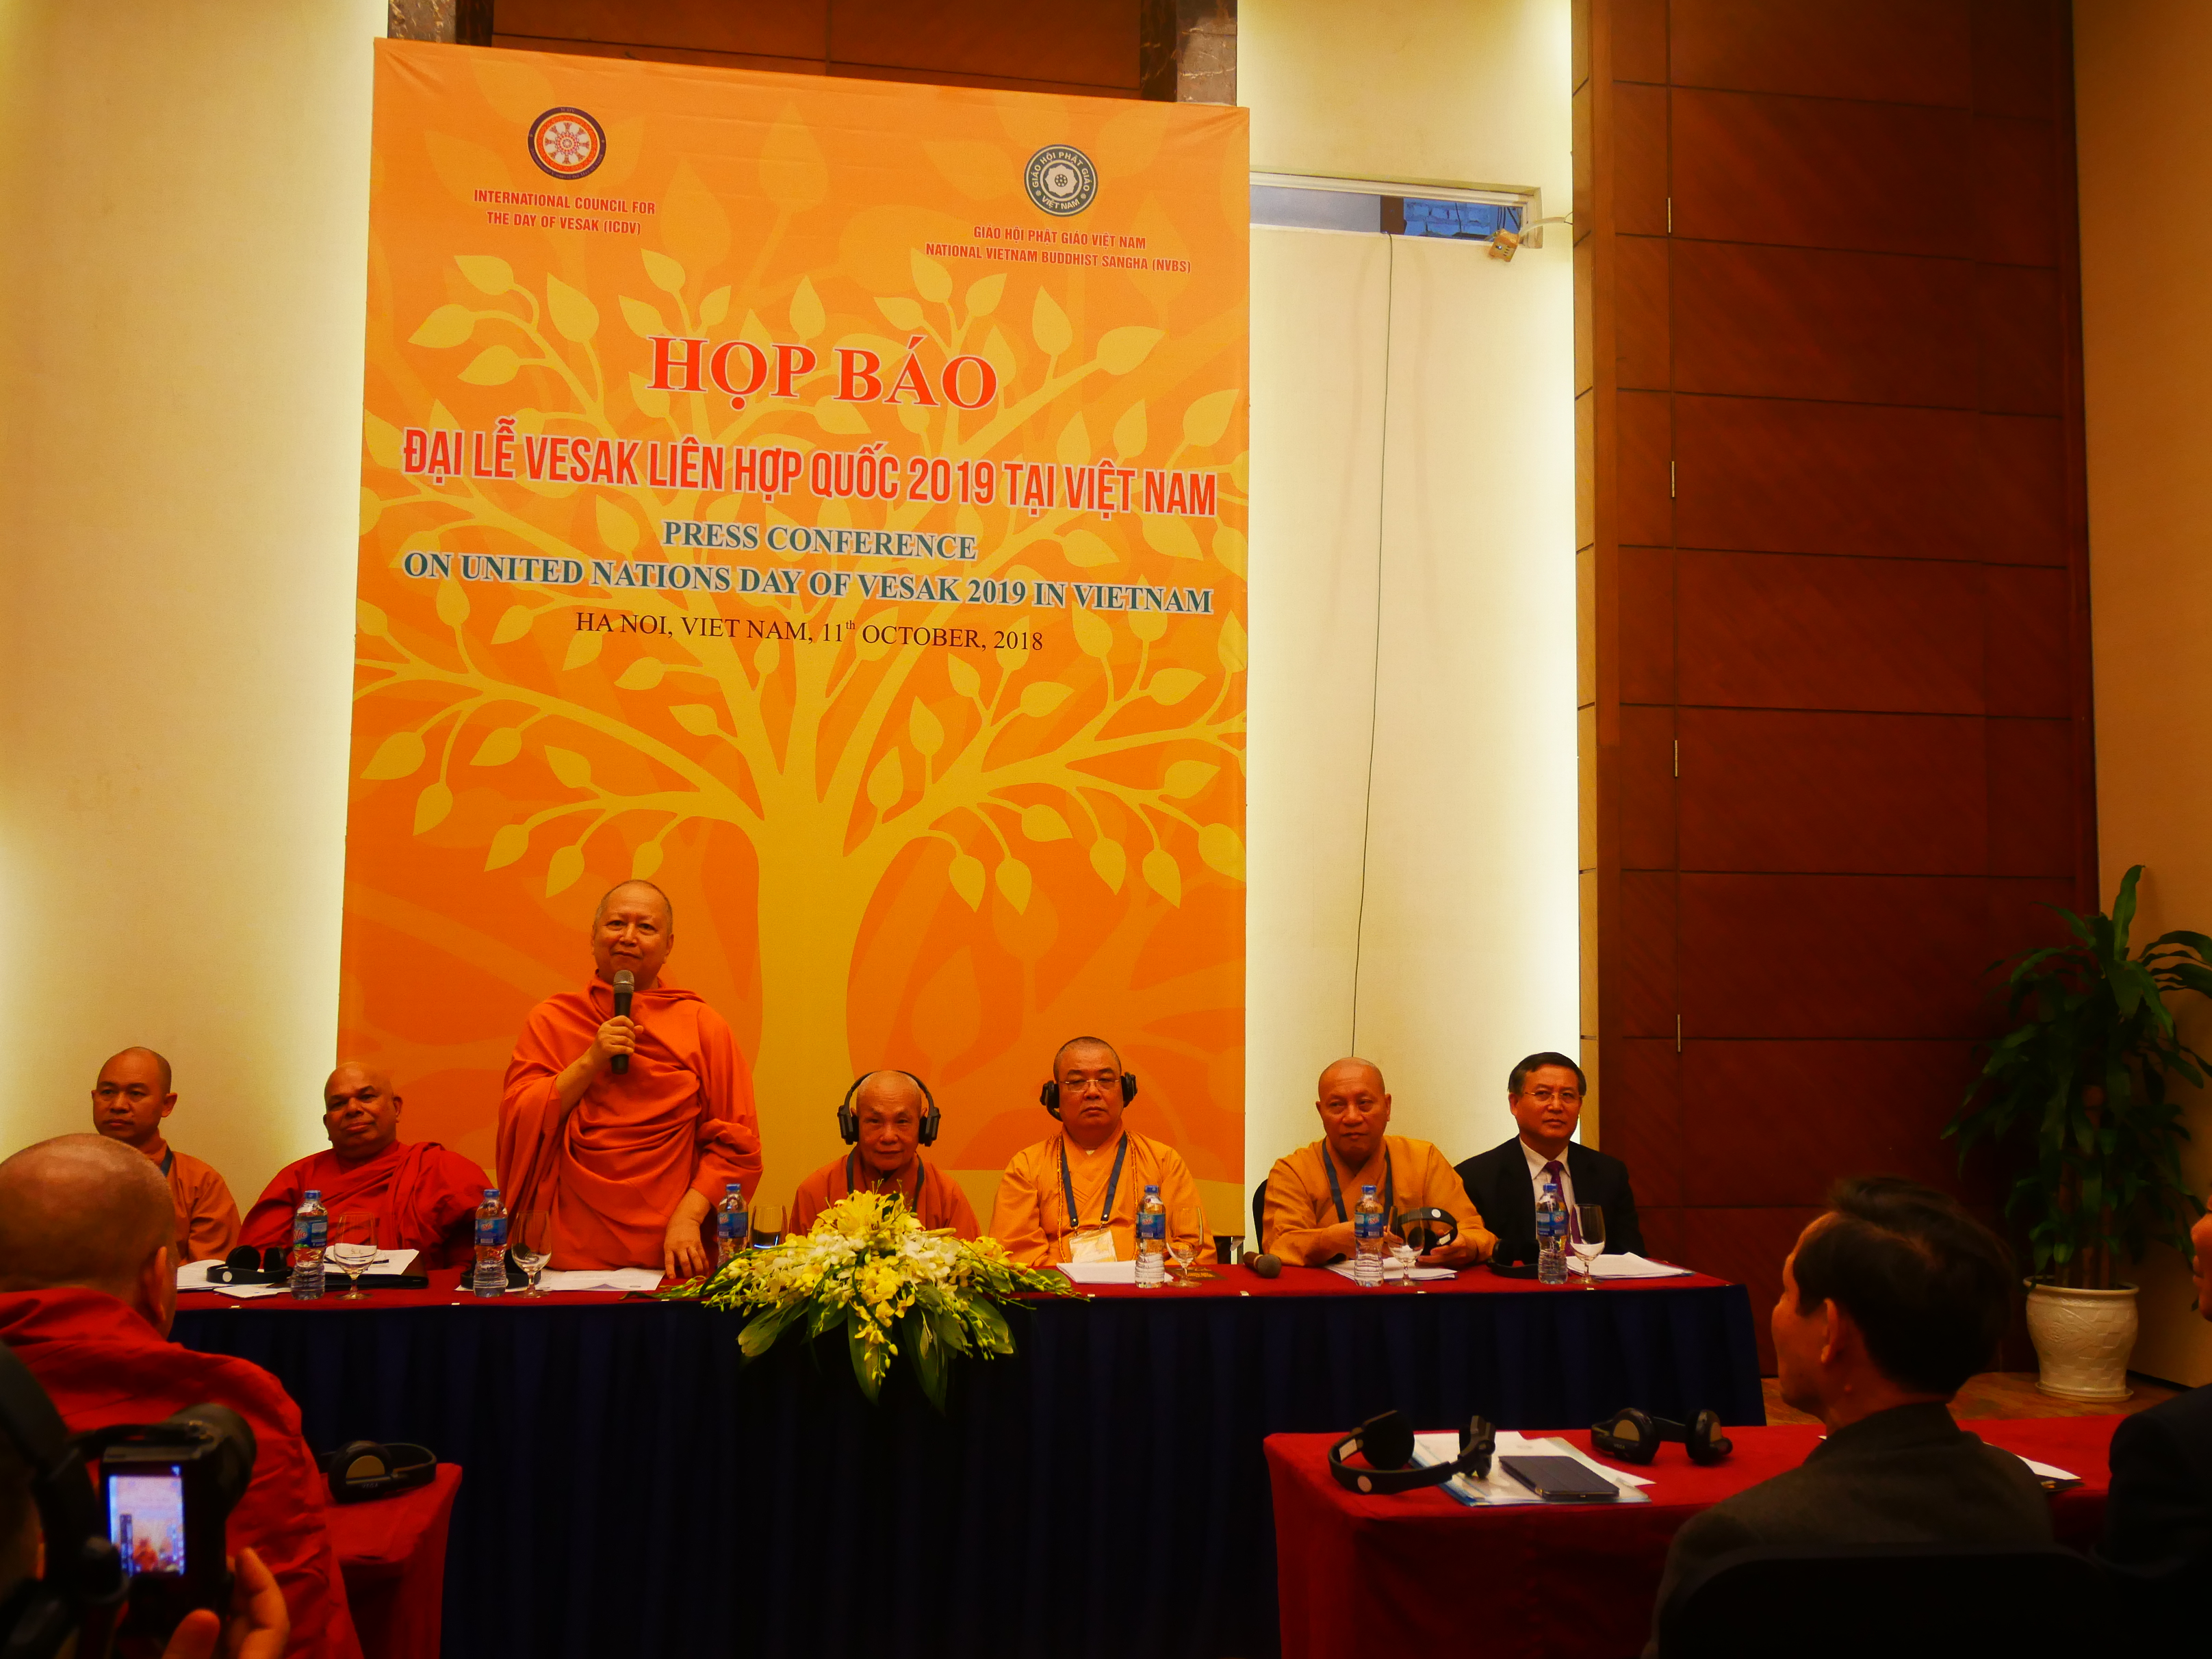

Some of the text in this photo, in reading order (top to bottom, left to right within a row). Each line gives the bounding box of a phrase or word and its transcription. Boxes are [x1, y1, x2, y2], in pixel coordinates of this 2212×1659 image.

[1031, 151, 1092, 192] GIÁO HỘI PHẬT GIÁO
[474, 189, 655, 215] INTERNATIONAL COUNCIL FOR
[1042, 195, 1080, 209] VIỆT NAM
[487, 211, 641, 236] THE DAY OF VESAK (ICDV)
[973, 224, 1146, 250] GIÁO HỘI PHẬT GIÁO VIỆT NAM
[926, 243, 1191, 273] NATIONAL VIETNAM BUDDHIST SANGHA (NVBS)
[646, 335, 997, 411] HỌP BÁO
[402, 416, 1216, 519] ĐẠI LỄ VESAK LIÊN HỢP QUỐC 2019 TẠI VIỆT NAM
[664, 521, 977, 560] PRESS CONFERENCE
[403, 552, 1211, 613] ON UNITED NATIONS DAY OF VESAK 2019 IN VIETNAM
[576, 613, 613, 632] HA
[621, 615, 672, 638] NOI,
[680, 617, 740, 637] VIET
[747, 620, 812, 643] NAM,
[863, 626, 986, 651] OCTOBER,
[994, 631, 1042, 650] 2018
